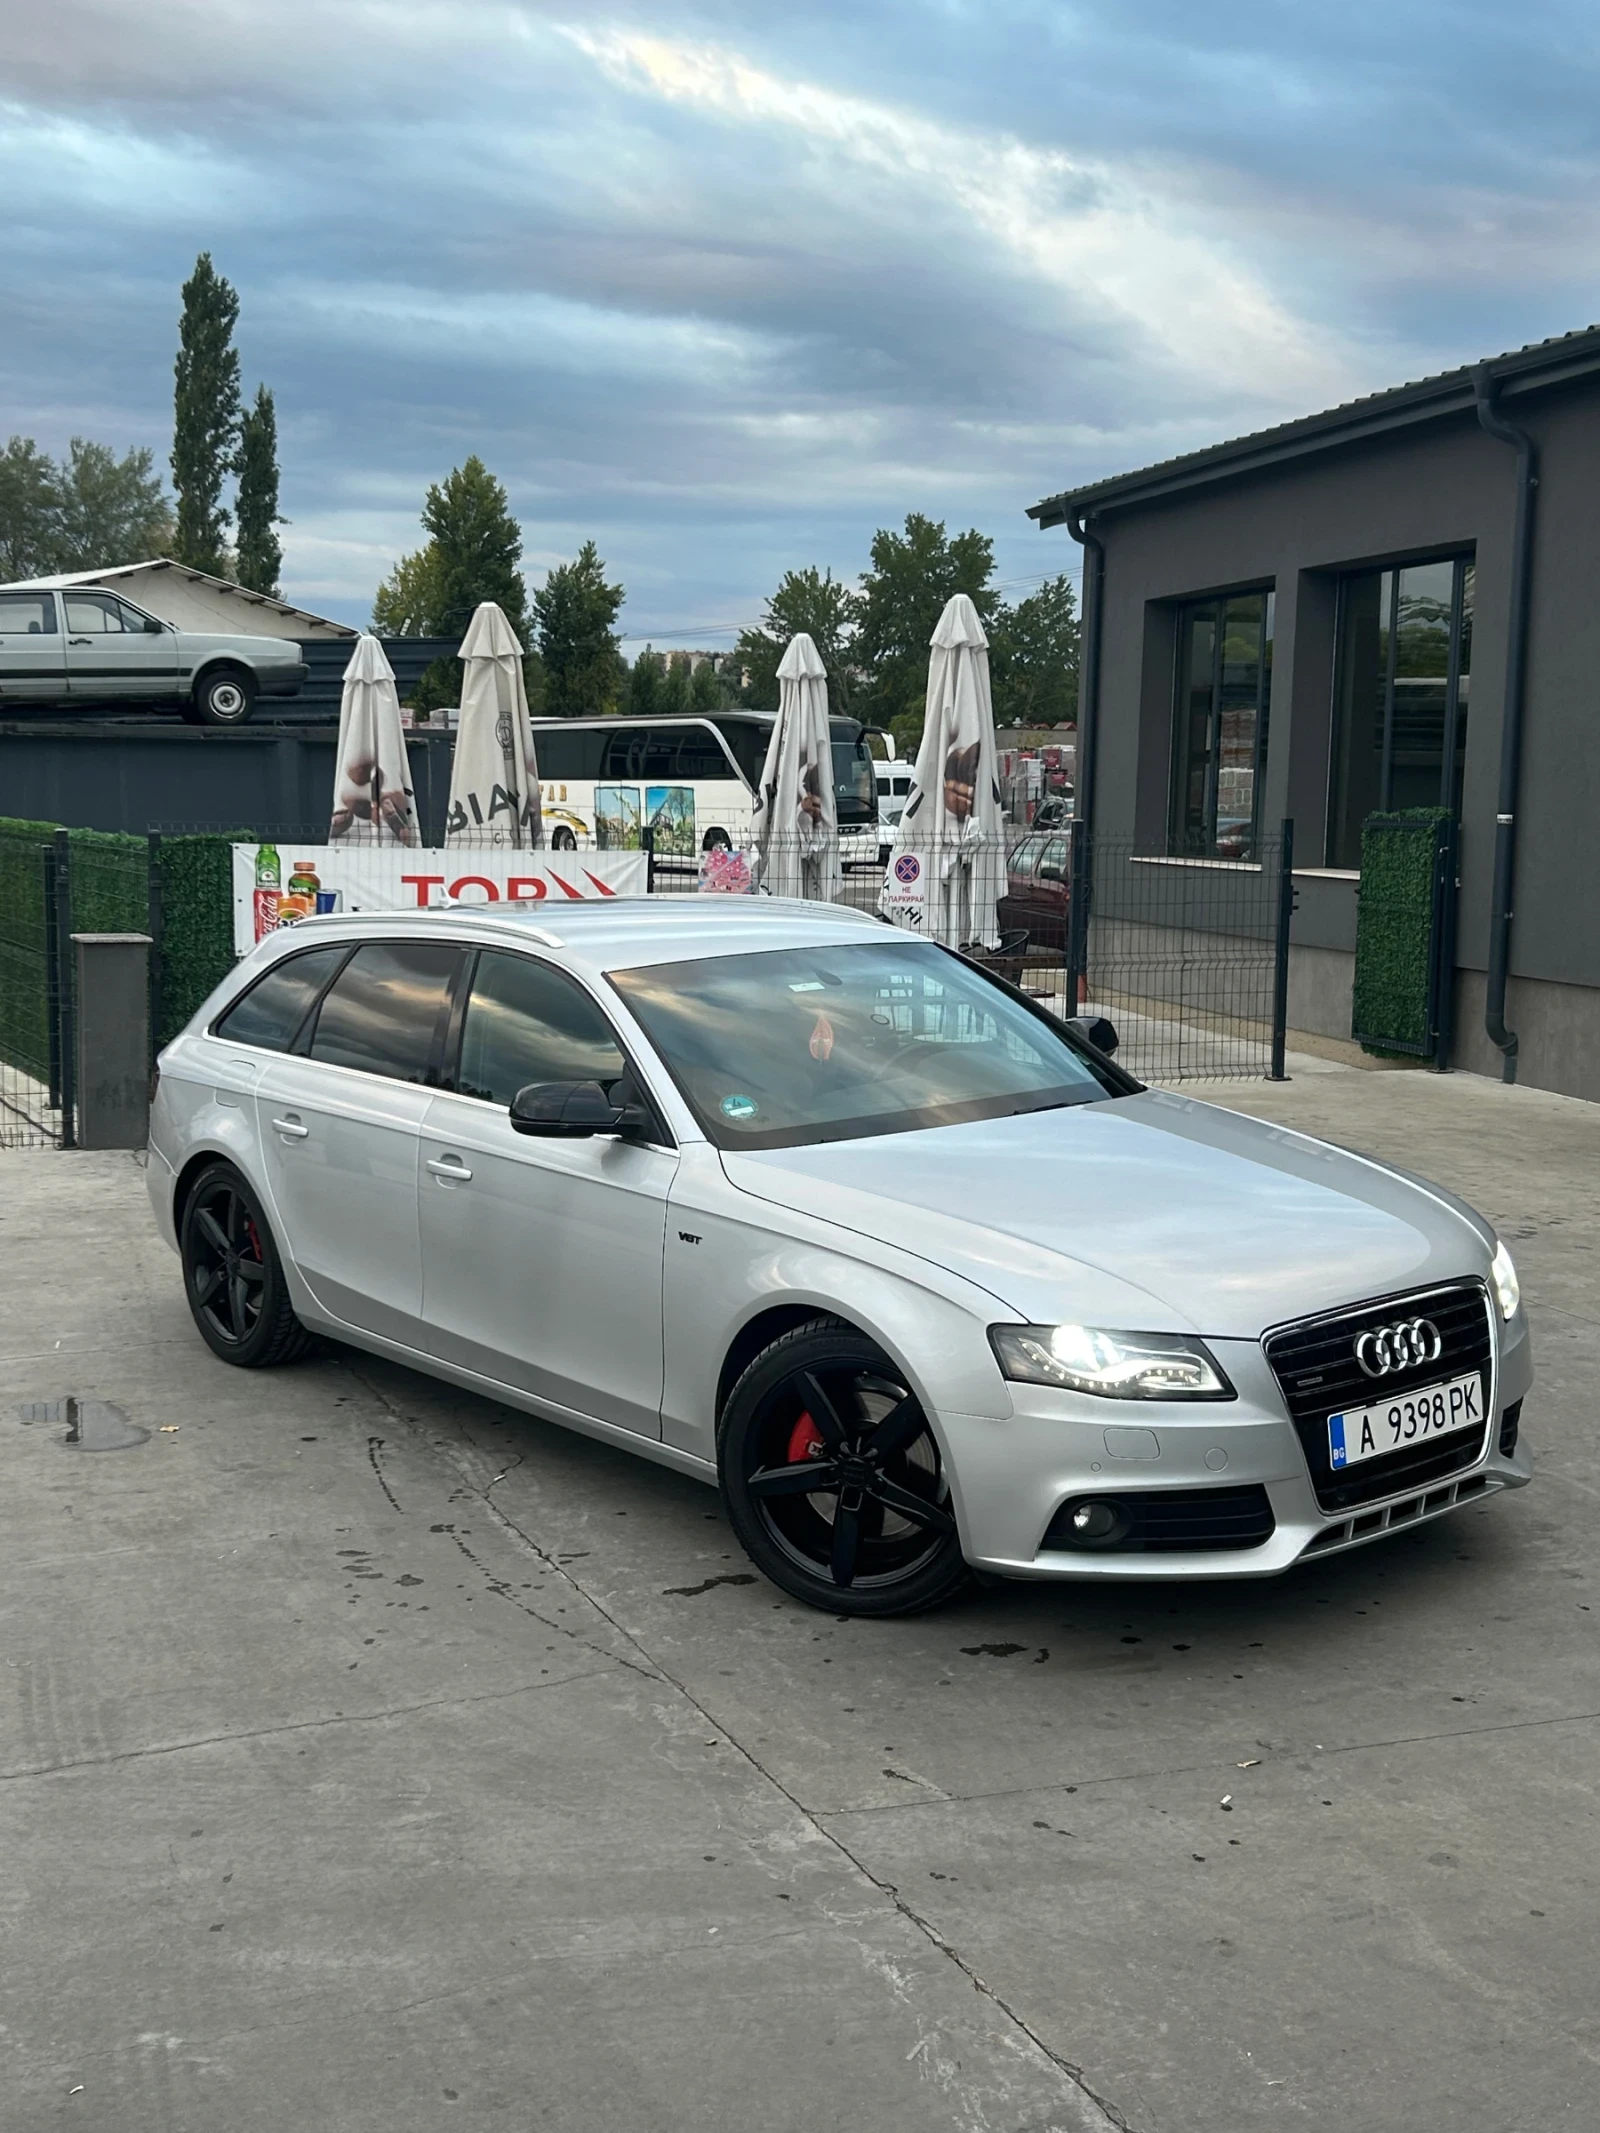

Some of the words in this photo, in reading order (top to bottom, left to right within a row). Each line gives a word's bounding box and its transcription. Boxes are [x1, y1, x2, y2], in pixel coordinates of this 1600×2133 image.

[902, 886, 911, 894] НЕ
[888, 894, 924, 902] ПАРКИРАЙ
[1360, 1415, 1376, 1454] A
[1388, 1393, 1446, 1444] 9398
[1449, 1381, 1479, 1425] PK
[1333, 1447, 1345, 1460] BG
